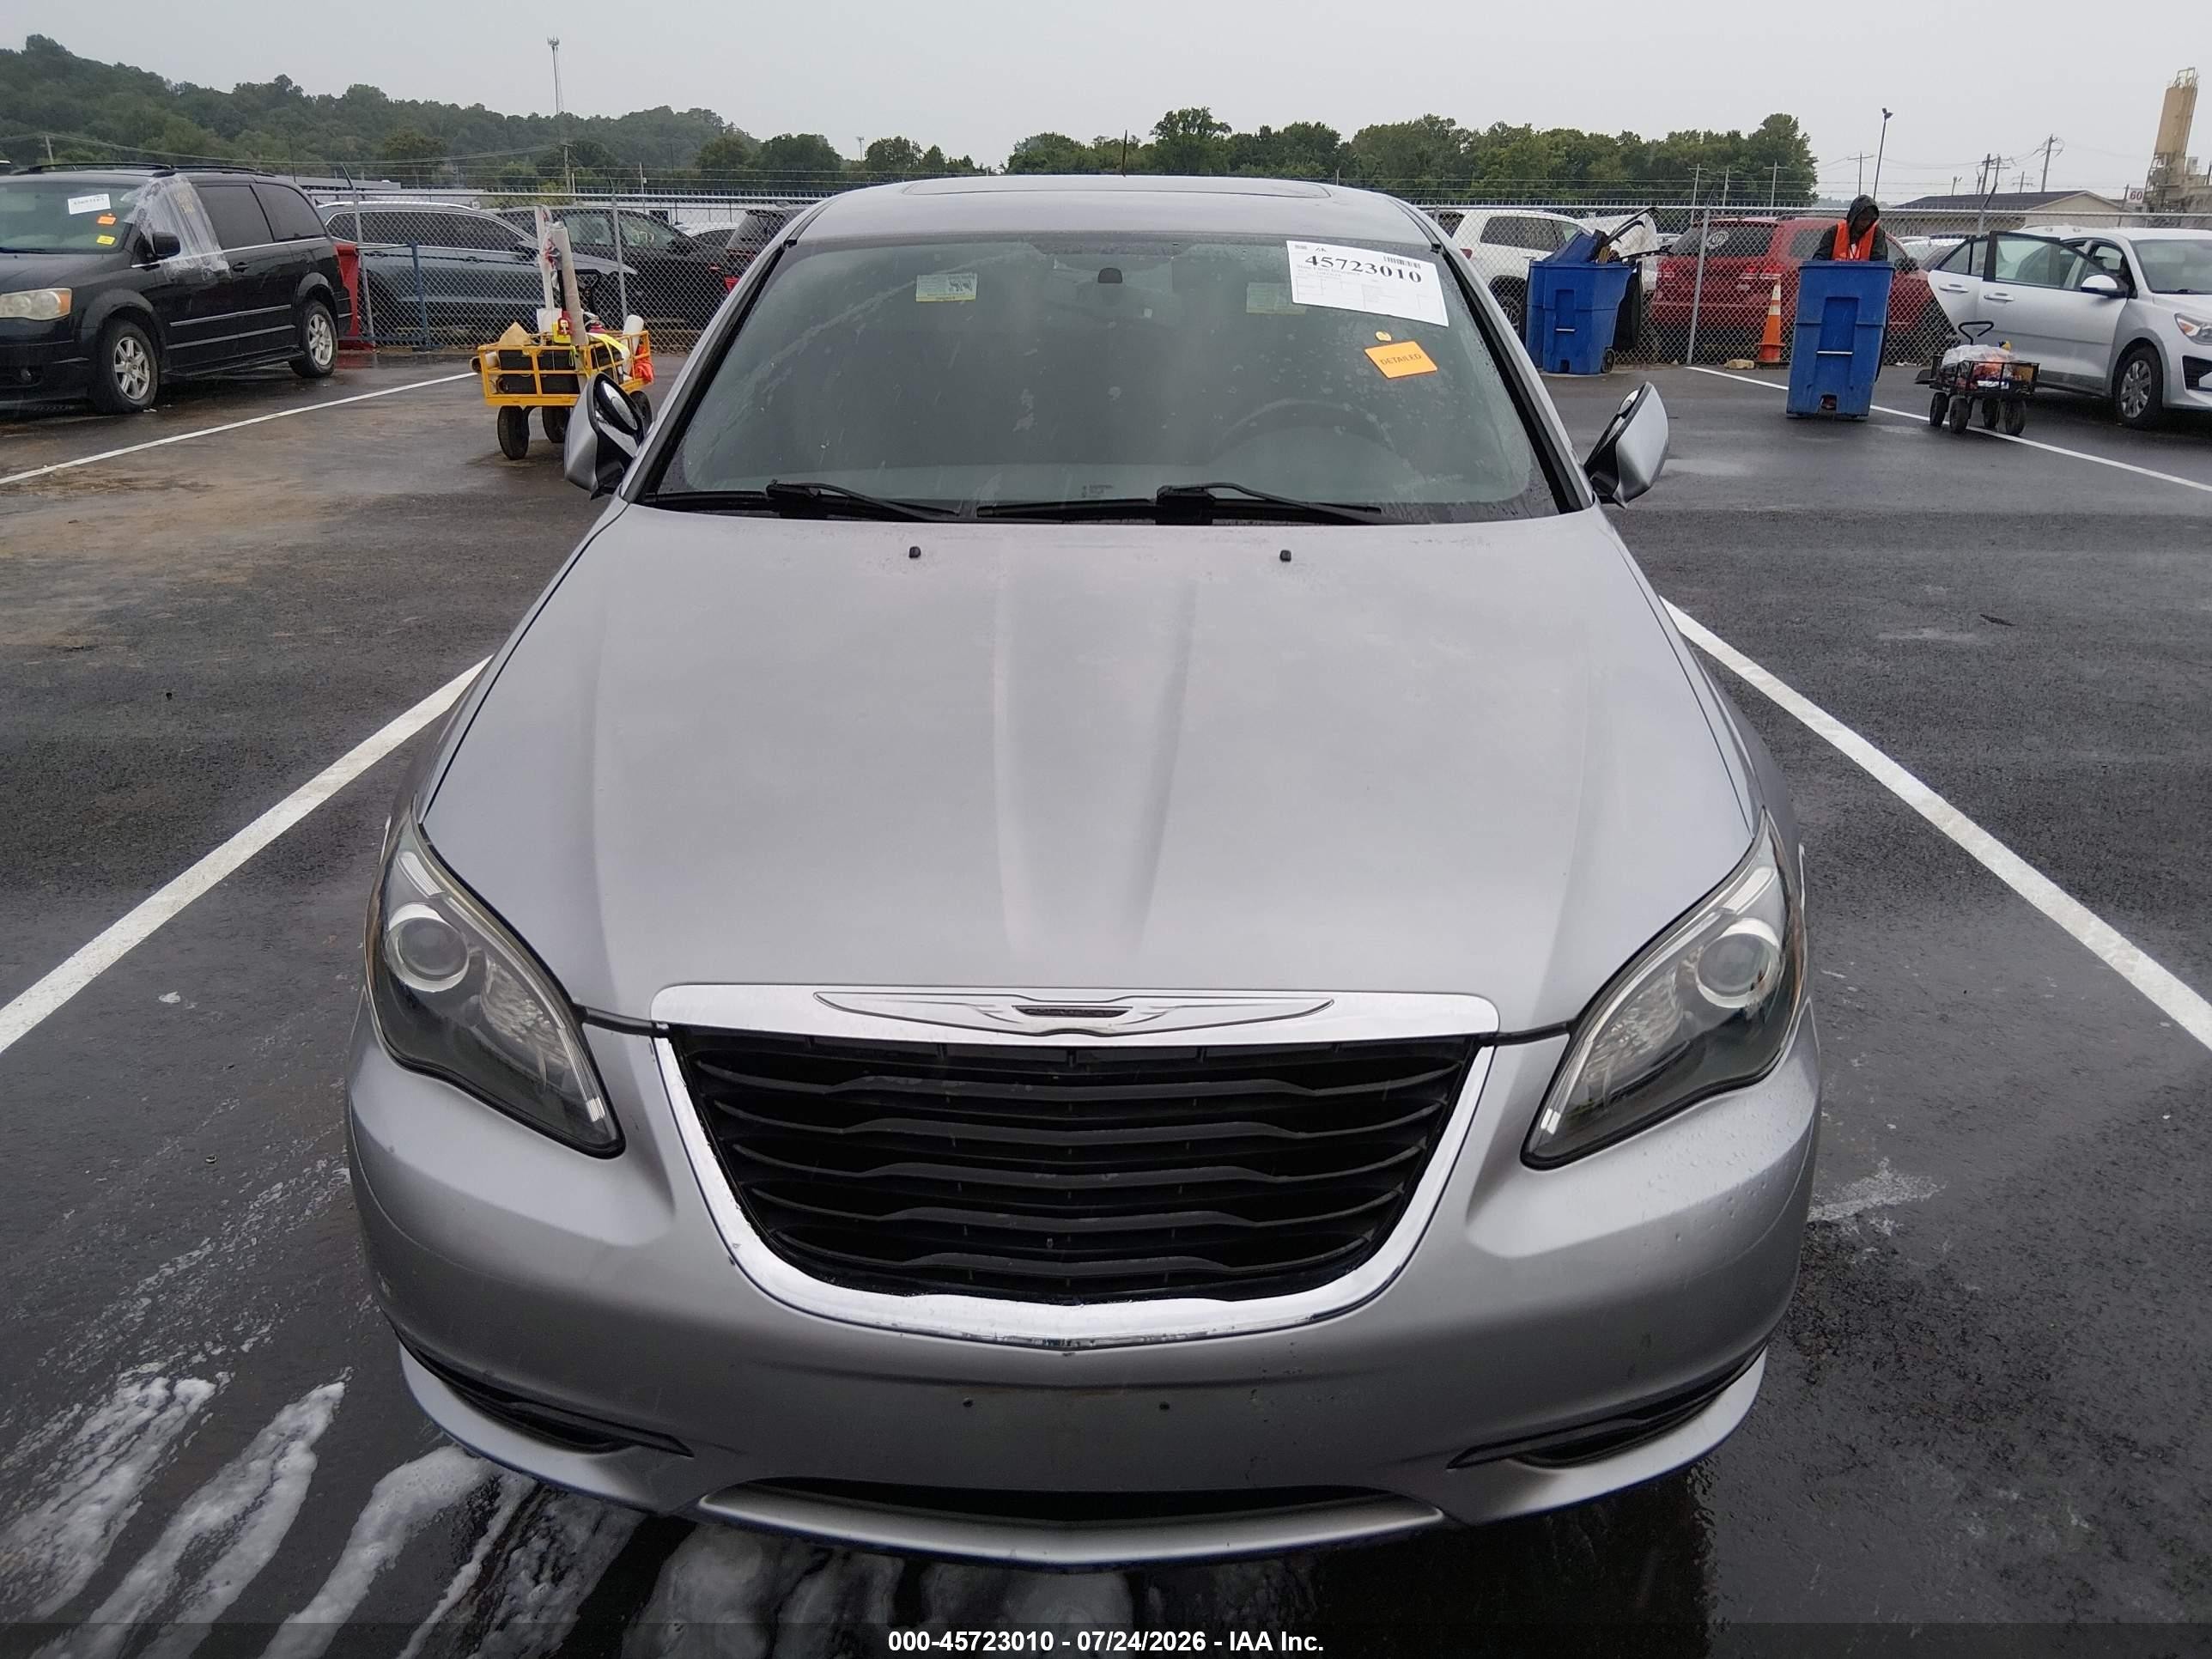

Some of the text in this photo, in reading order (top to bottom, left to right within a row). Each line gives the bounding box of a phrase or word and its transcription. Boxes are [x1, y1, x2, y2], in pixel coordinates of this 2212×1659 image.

[2130, 191, 2143, 201] 60
[1305, 255, 1422, 283] 45723010
[1380, 354, 1422, 365] DETAILED
